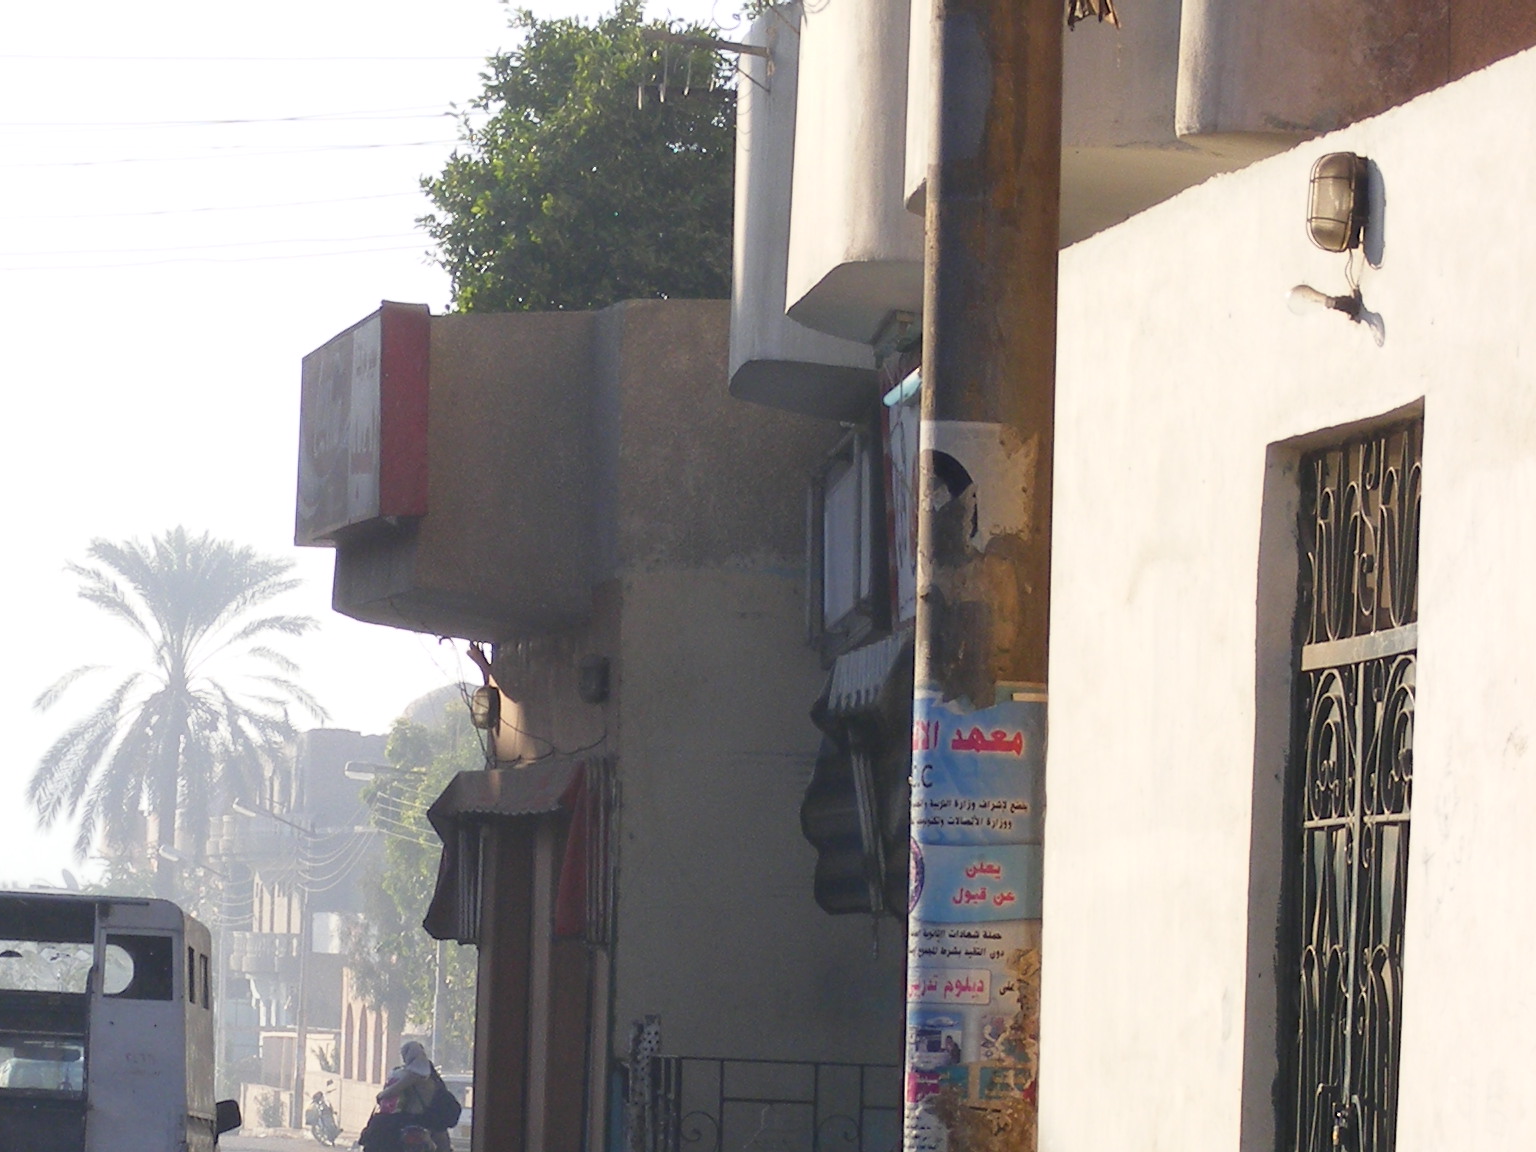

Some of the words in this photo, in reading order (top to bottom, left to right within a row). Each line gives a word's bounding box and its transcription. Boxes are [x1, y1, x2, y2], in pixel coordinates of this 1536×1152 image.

[951, 727, 1023, 756] معهد
[954, 799, 976, 811] وزارة
[965, 862, 1001, 879] يعلن
[953, 887, 987, 905] قبول
[993, 891, 1015, 906] عن
[989, 950, 1005, 959] دون
[944, 976, 984, 999] دبلوم
